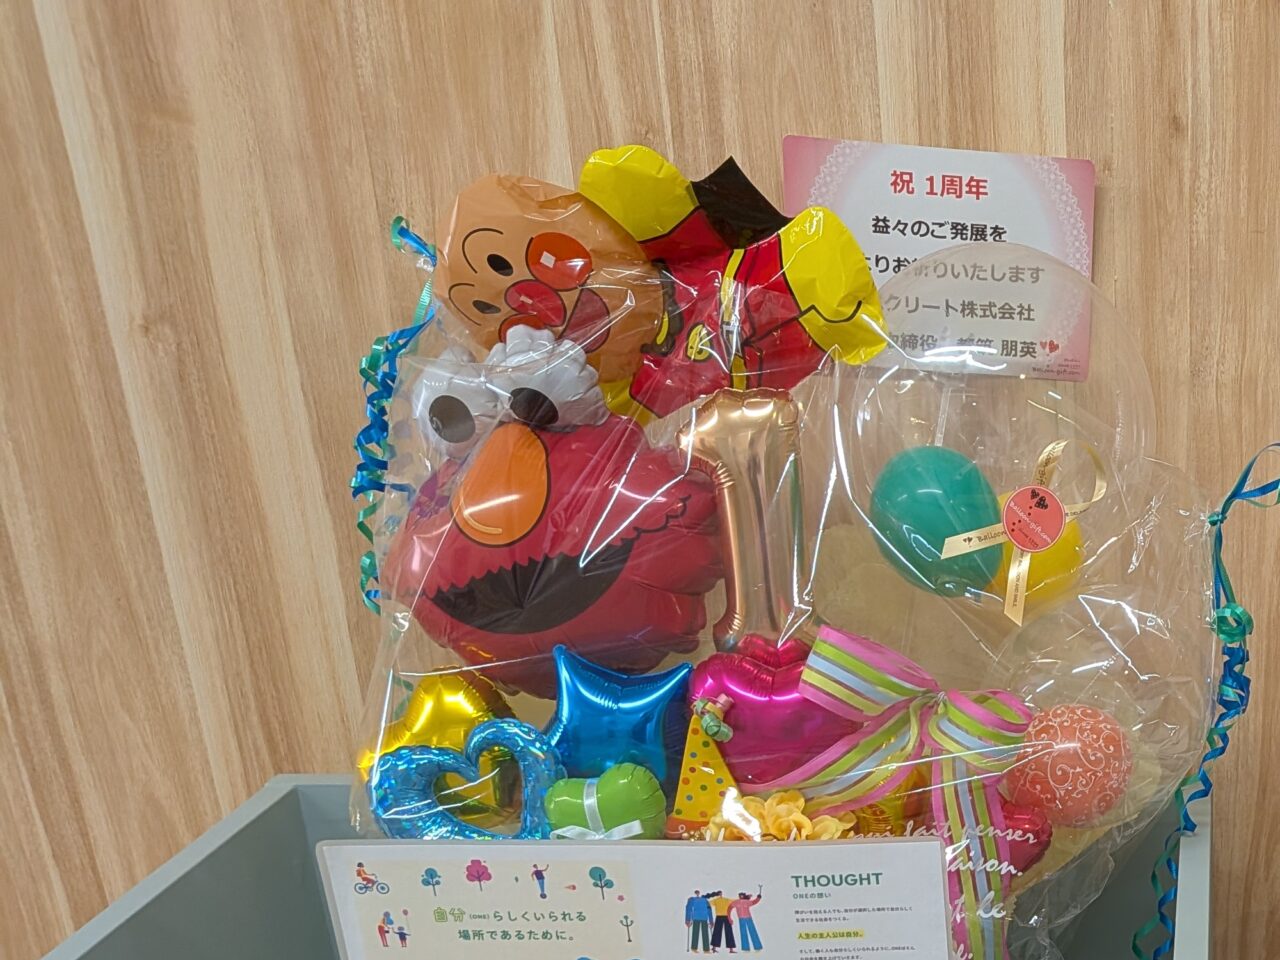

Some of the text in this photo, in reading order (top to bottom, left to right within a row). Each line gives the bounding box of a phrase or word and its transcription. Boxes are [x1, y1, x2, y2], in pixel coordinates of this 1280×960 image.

[890, 171, 988, 200] 祝 1周年
[871, 215, 1007, 242] 益々のご発展を
[864, 254, 1044, 284] りおりいたします
[1000, 339, 1037, 359] 朋英
[790, 872, 883, 888] THOUGHT
[458, 929, 575, 941] 場所であるために。
